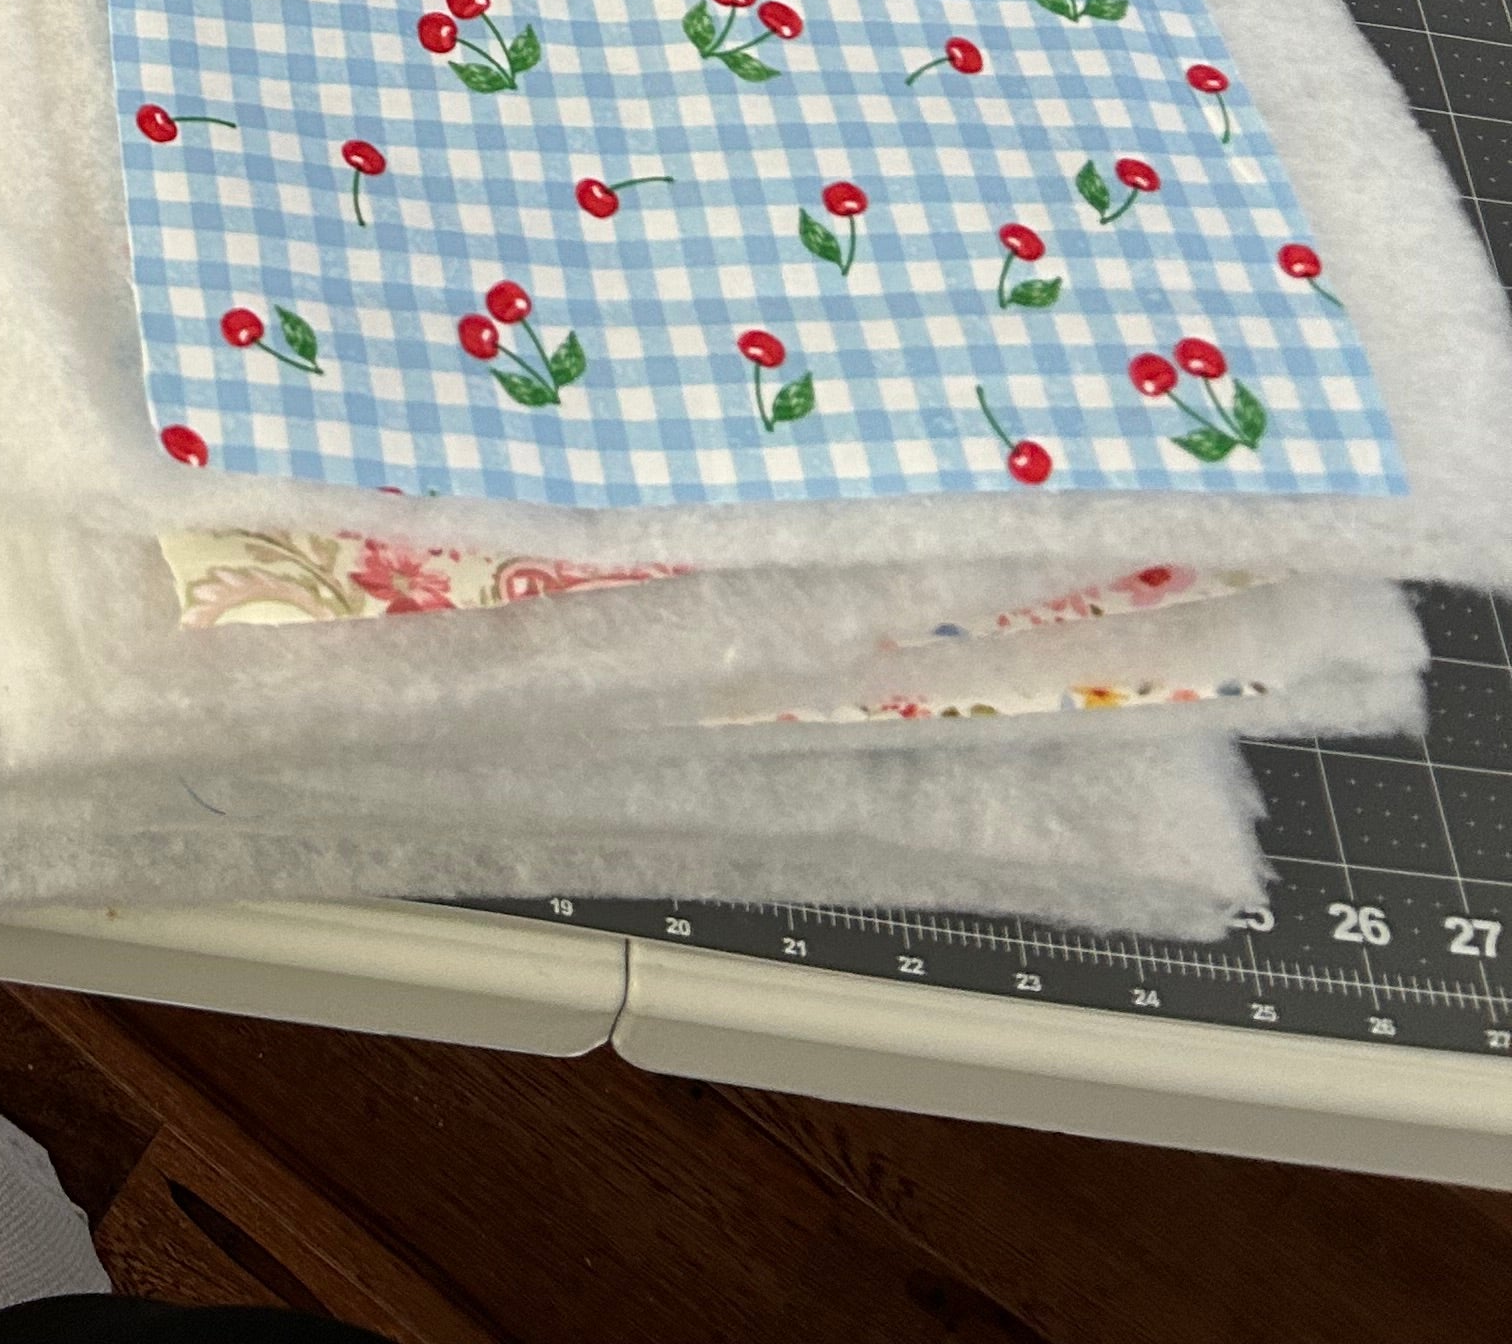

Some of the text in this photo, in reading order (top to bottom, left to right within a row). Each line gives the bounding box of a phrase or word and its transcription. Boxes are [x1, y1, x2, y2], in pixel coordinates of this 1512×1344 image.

[550, 897, 1511, 1049] 19 20 21 22 23 24 25 26 27
[1328, 903, 1391, 946] 26
[1444, 916, 1502, 958] 27
